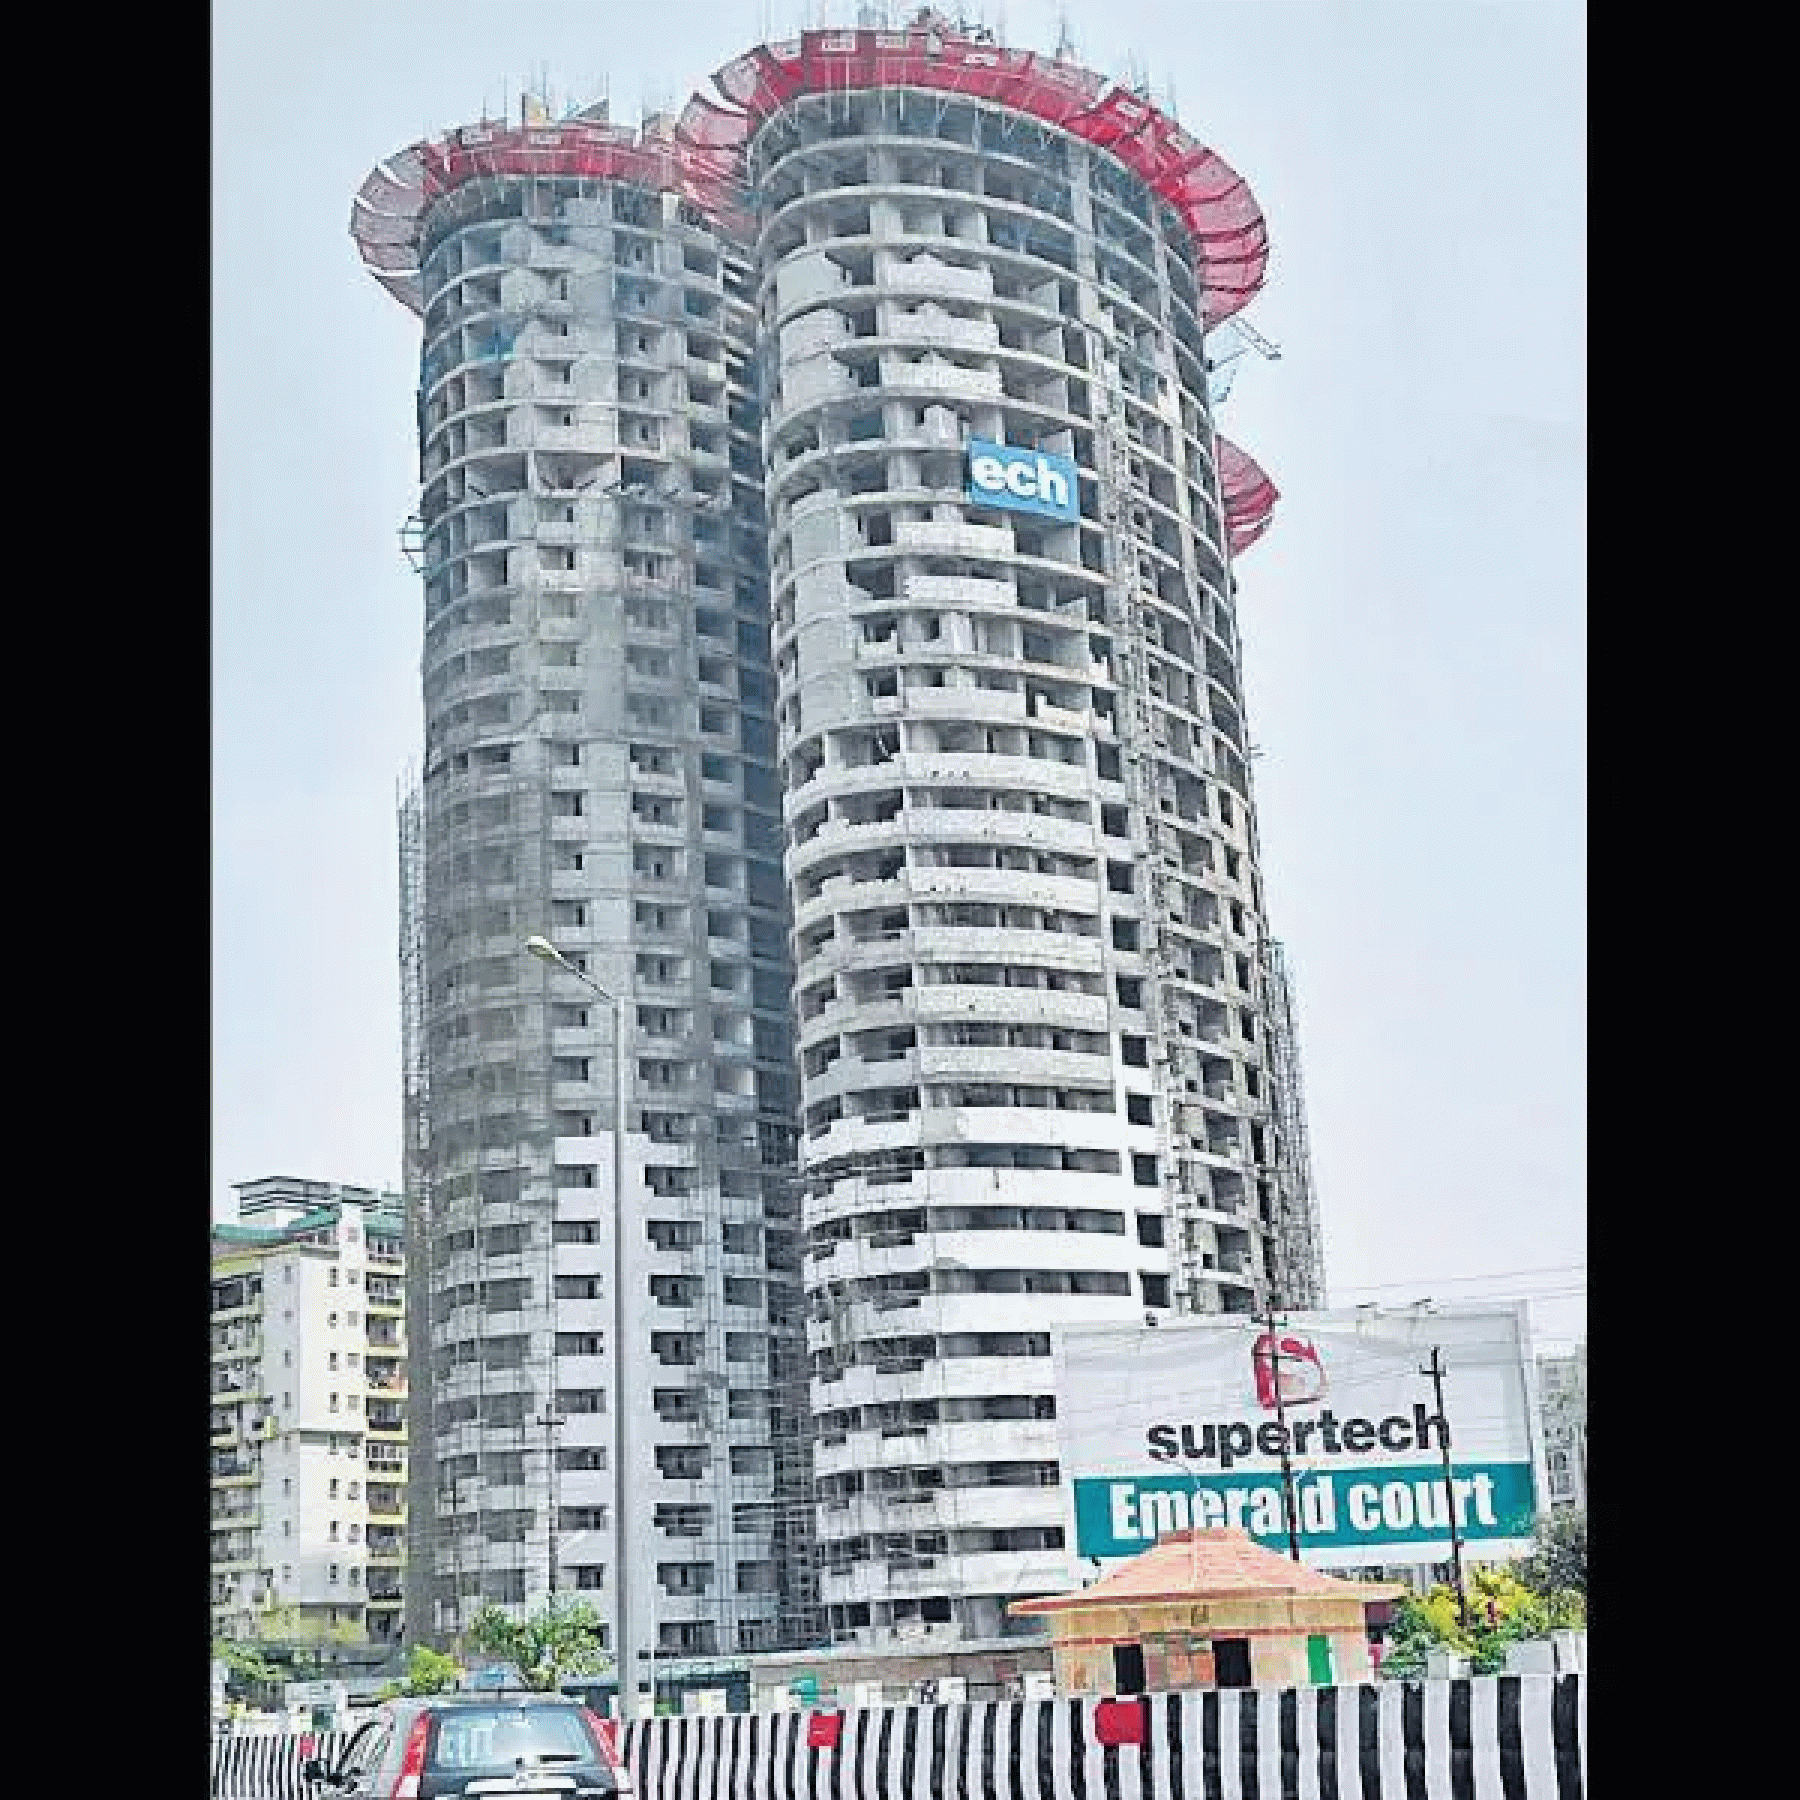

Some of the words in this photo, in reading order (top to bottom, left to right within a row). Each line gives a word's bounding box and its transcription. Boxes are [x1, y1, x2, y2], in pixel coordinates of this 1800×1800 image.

[971, 455, 1069, 505] ech
[1147, 1403, 1451, 1468] supertech
[1348, 1472, 1498, 1531] court
